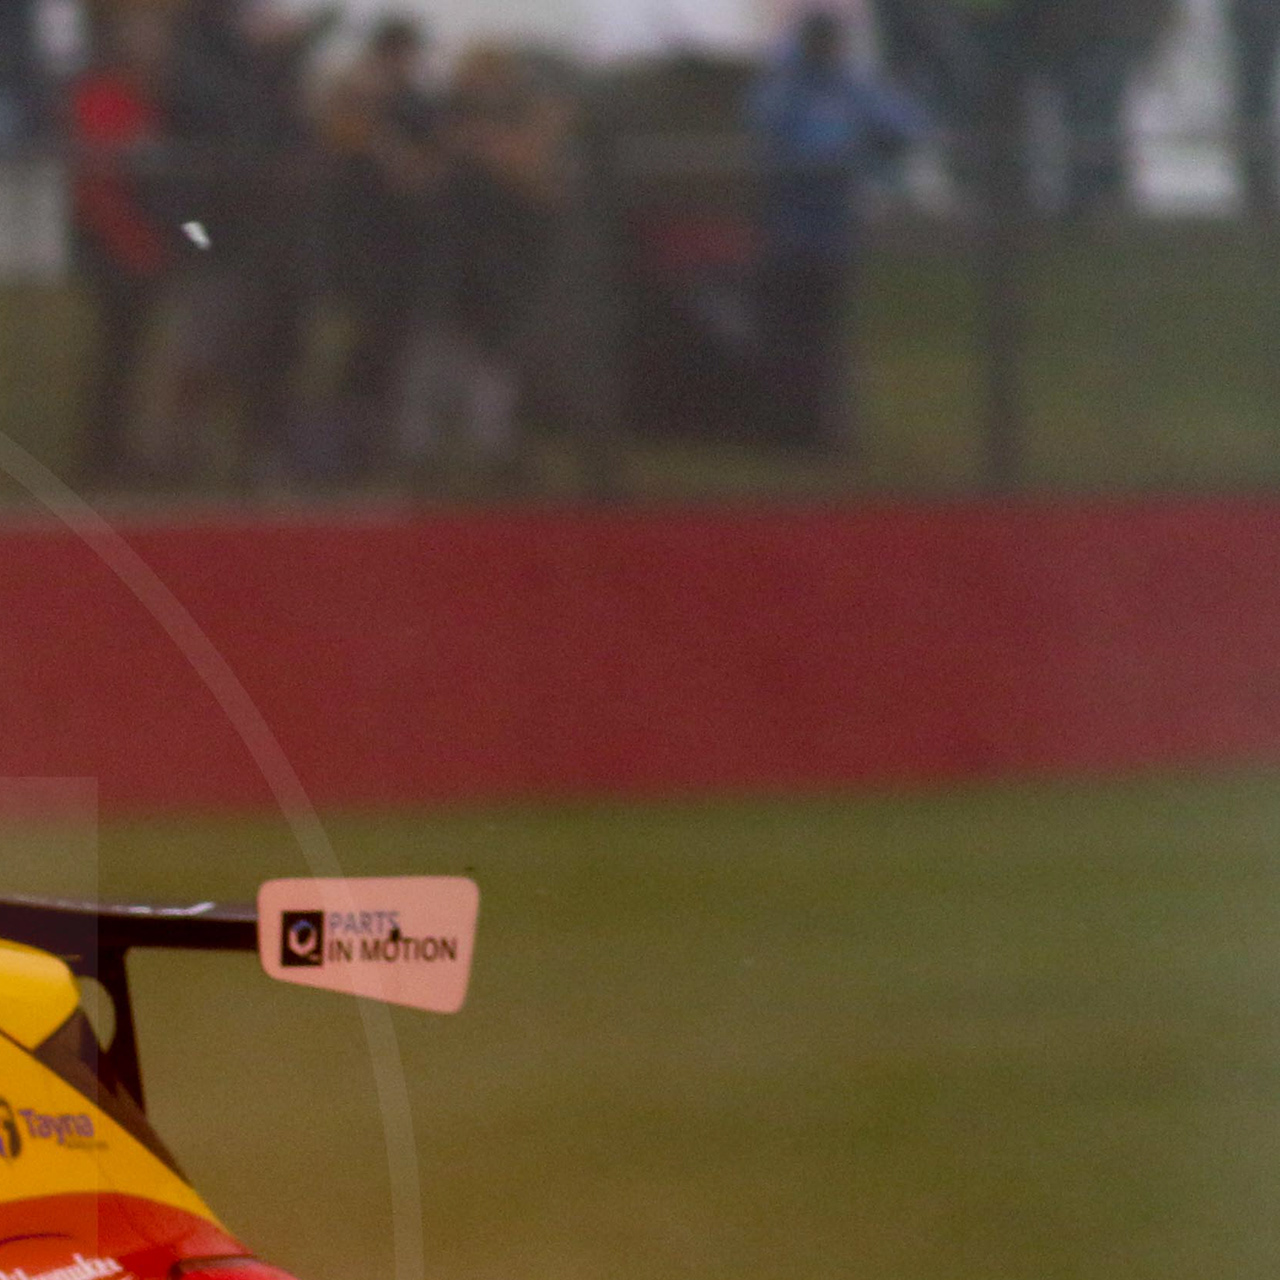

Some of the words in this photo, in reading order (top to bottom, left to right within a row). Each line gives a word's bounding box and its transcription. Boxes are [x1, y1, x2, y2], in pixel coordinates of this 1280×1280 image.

[328, 911, 399, 935] PARTS
[328, 937, 353, 962] IN
[360, 936, 458, 962] MOTION
[17, 1108, 96, 1145] Tayna
